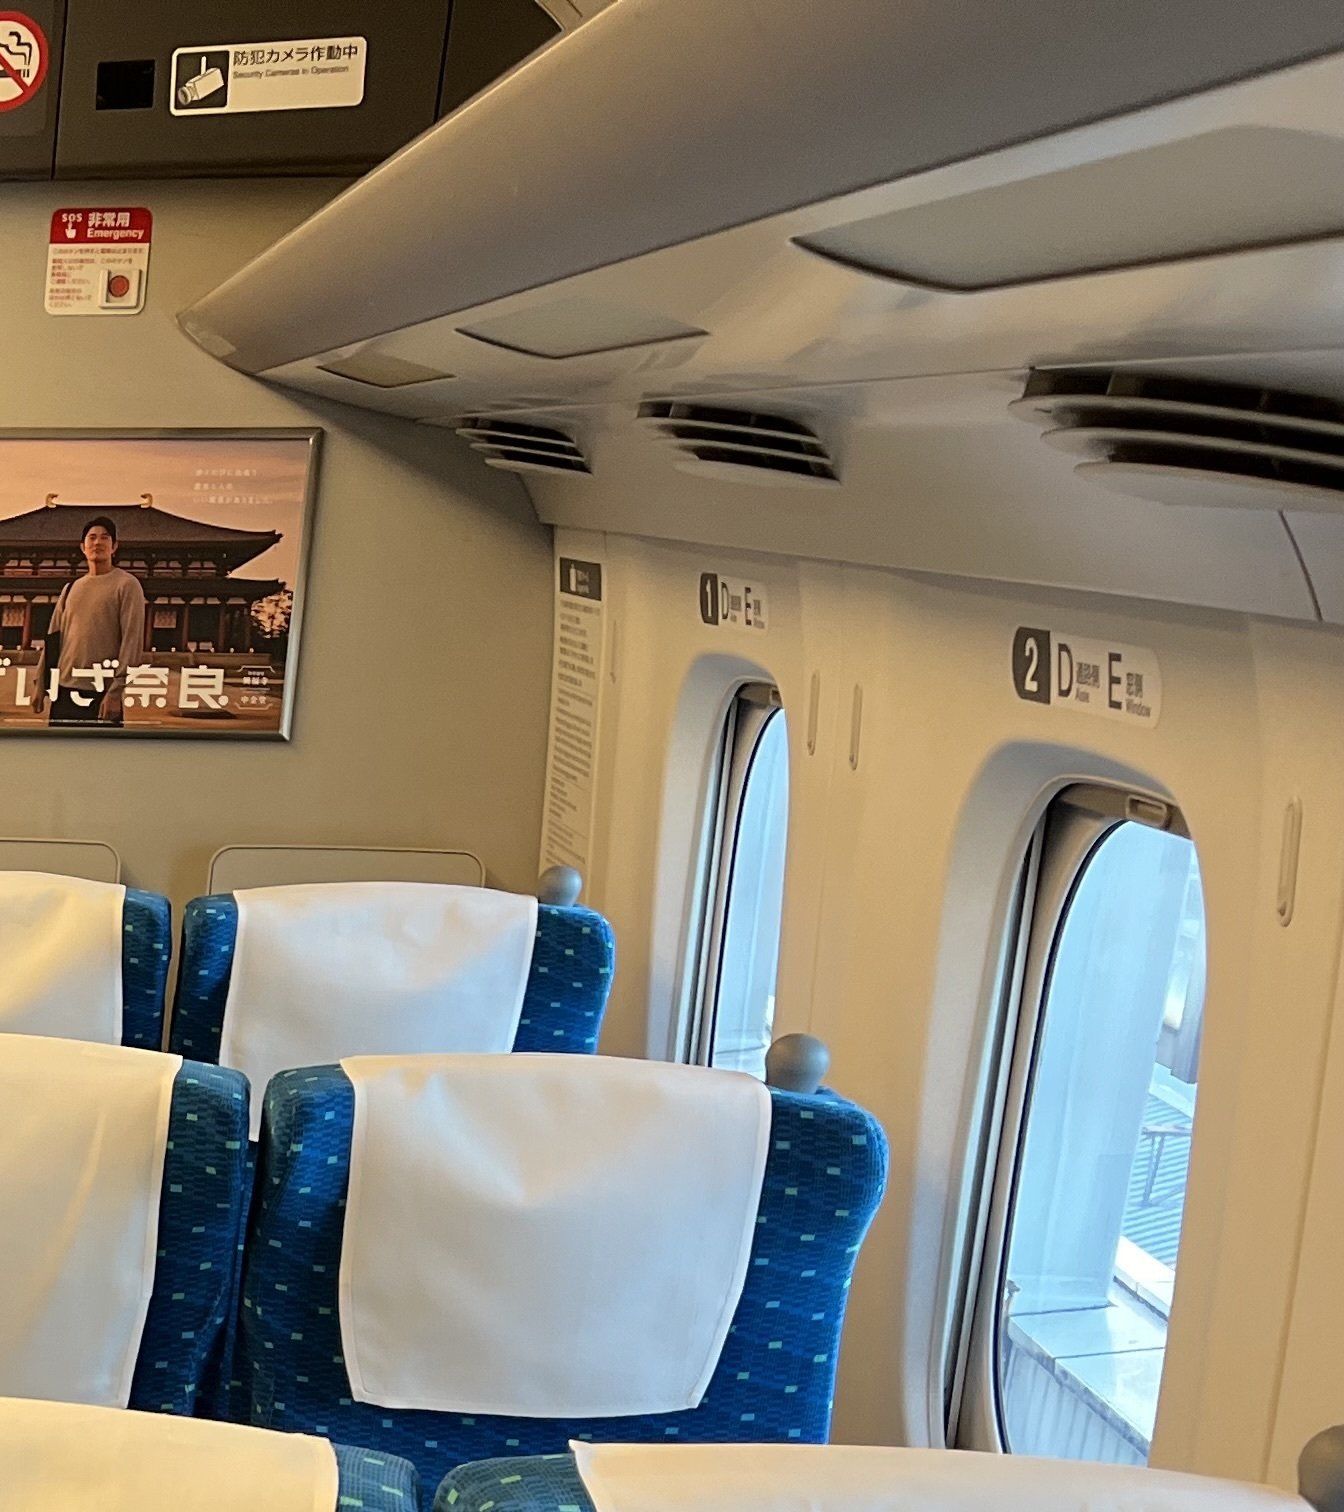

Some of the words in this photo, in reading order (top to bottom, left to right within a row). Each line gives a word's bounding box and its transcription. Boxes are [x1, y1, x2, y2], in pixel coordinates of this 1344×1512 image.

[233, 44, 358, 66] 防犯カメラ作動中
[62, 213, 83, 222] SOS
[88, 212, 130, 228] 非常用
[87, 228, 144, 240] Emergency
[706, 579, 712, 617] 1
[721, 582, 729, 620] D
[745, 587, 752, 626] E
[1024, 637, 1038, 692] 2
[1058, 643, 1073, 698] D
[1108, 652, 1122, 710] E
